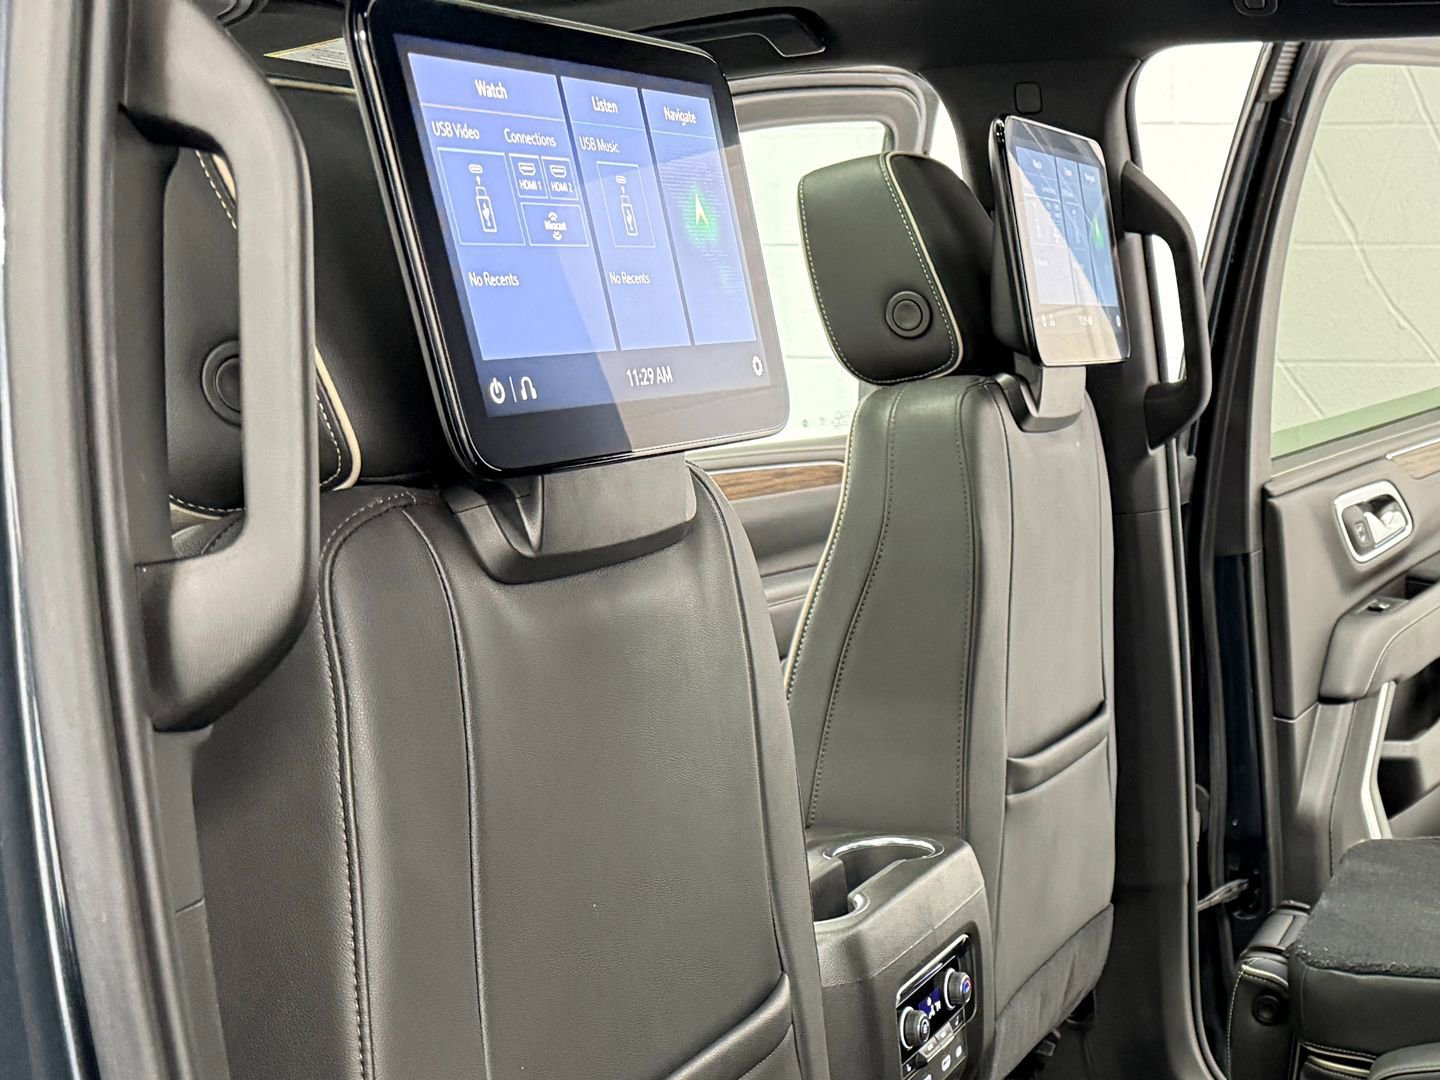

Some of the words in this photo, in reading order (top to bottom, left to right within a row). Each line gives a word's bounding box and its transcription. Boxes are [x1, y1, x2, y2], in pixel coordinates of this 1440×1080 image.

[474, 79, 508, 99] Watch
[591, 95, 618, 113] Listen
[663, 106, 697, 126] Navigate
[432, 120, 453, 137] USB
[452, 122, 480, 139] Video
[503, 128, 557, 147] Connections
[578, 135, 597, 151] USB
[596, 137, 620, 153] Music
[519, 180, 537, 191] HDMI
[551, 181, 569, 193] HDMI
[469, 271, 483, 286] No
[484, 271, 519, 286] Recents
[609, 271, 621, 285] No
[621, 271, 650, 285] Recents
[626, 367, 654, 388] 11:29
[656, 365, 674, 384] AM
